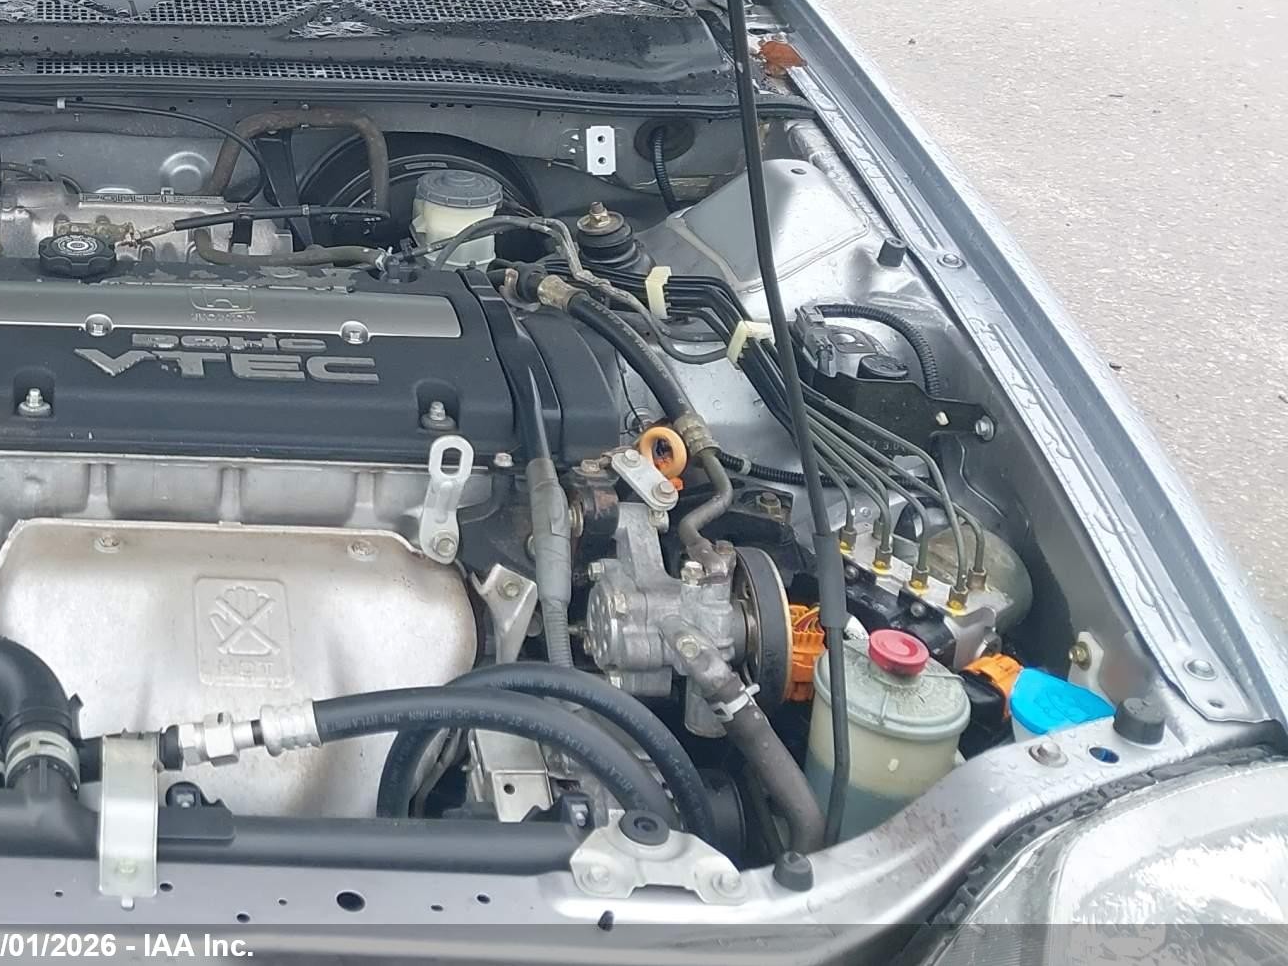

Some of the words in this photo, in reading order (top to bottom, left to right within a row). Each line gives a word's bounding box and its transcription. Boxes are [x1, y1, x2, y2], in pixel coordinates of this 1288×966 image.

[132, 332, 327, 352] DOHC
[74, 347, 380, 383] VTEC
[217, 657, 275, 676] HOT
